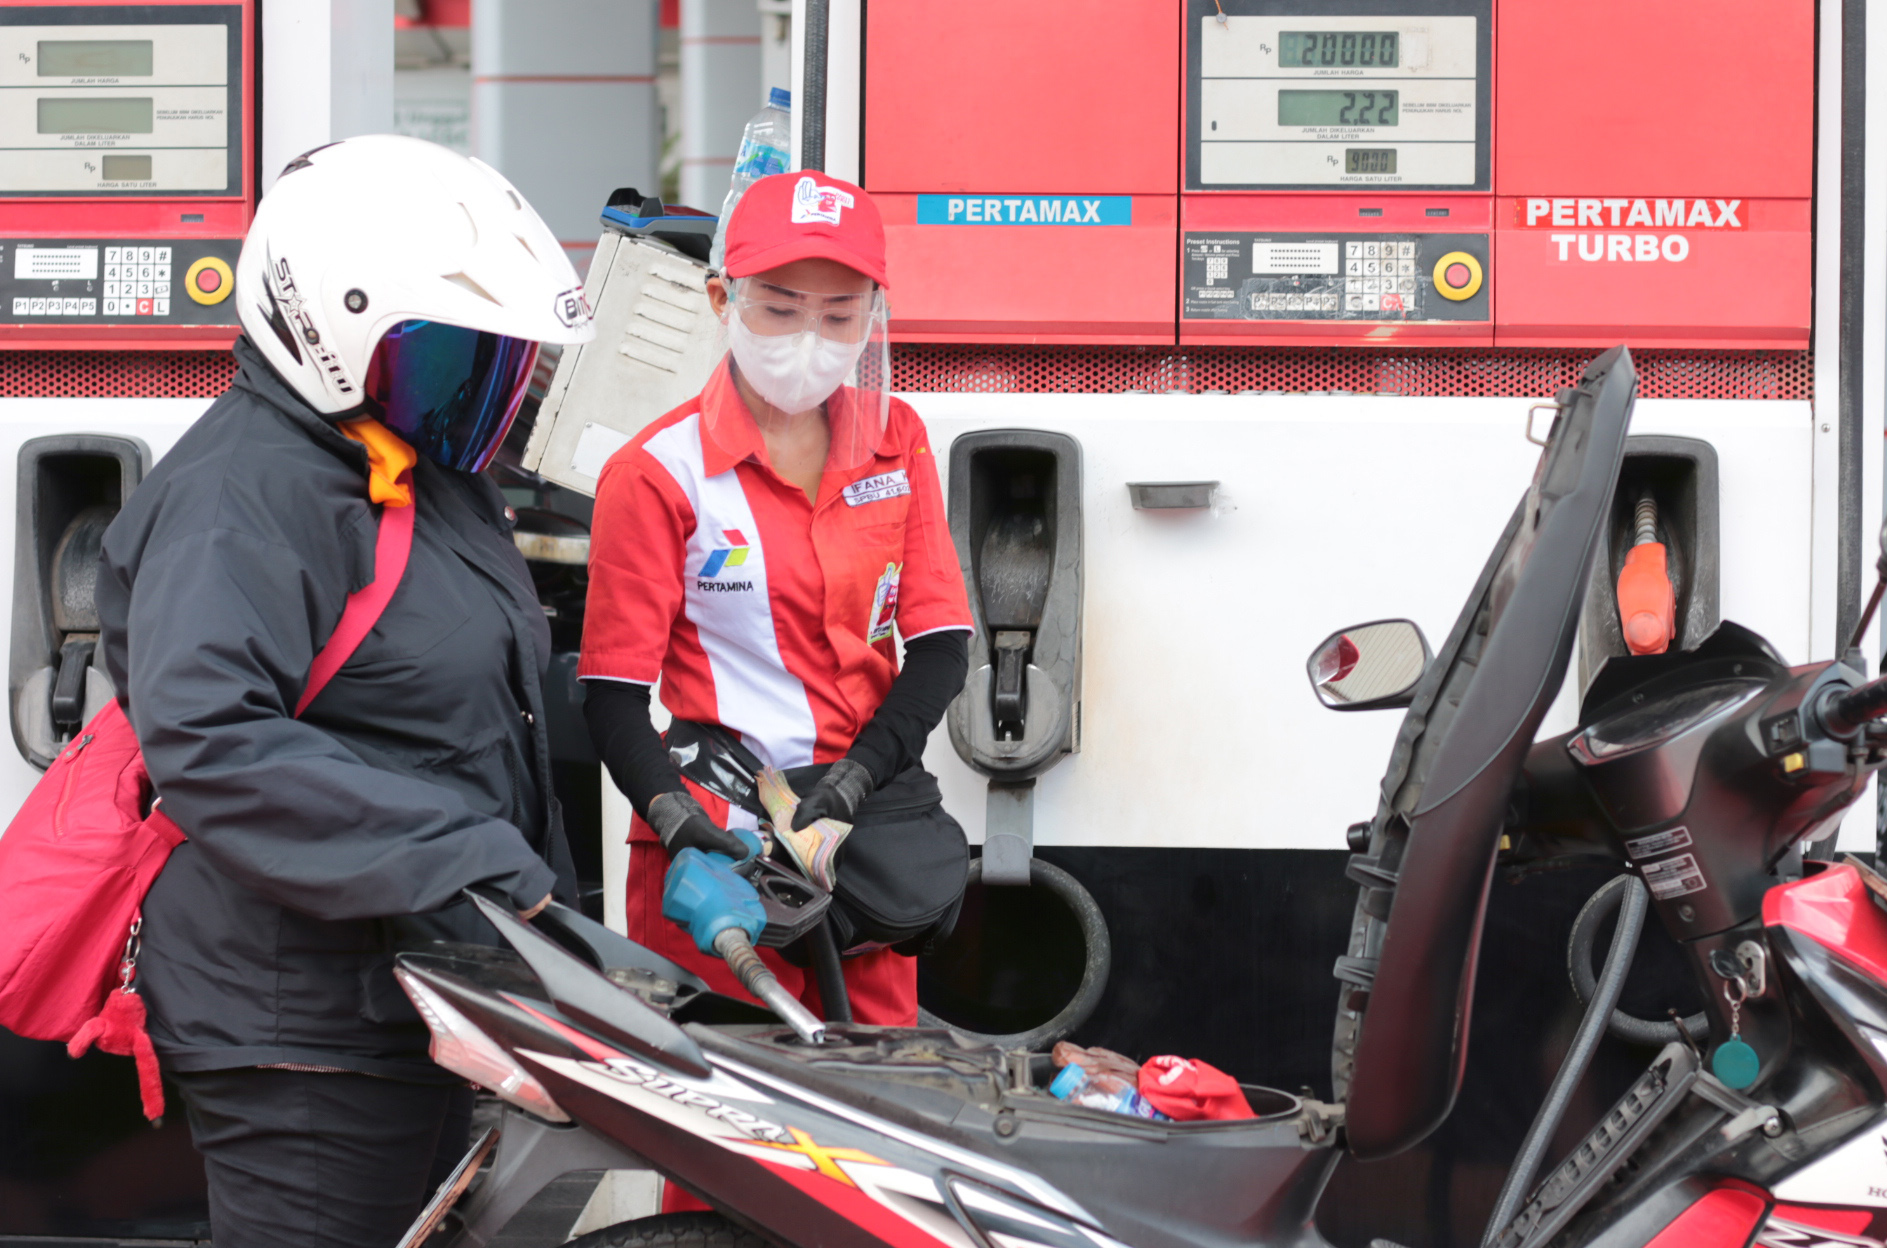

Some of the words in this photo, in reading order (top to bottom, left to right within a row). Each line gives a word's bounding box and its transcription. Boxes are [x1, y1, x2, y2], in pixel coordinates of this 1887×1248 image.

[1260, 44, 1272, 54] Rp
[1302, 34, 1395, 66] 20000
[19, 53, 30, 64] Rp
[1327, 155, 1339, 166] Rp
[84, 162, 96, 173] Rp
[948, 198, 1101, 223] PERTAMAX
[1526, 199, 1742, 227] PERTAMAX
[1350, 245, 1358, 256] 7
[1367, 245, 1376, 256] 8
[1385, 245, 1393, 256] 9
[1402, 245, 1411, 256] #
[1551, 234, 1690, 262] TURBO
[109, 251, 117, 261] 7
[126, 251, 133, 261] 8
[142, 251, 150, 261] 9
[159, 251, 167, 261] #
[108, 268, 116, 278] 4
[126, 268, 133, 278] 5
[142, 268, 150, 278] 6
[1350, 262, 1358, 273] 4
[1367, 262, 1376, 273] 5
[1385, 262, 1393, 273] 6
[109, 284, 115, 294] 1
[124, 284, 132, 294] 2
[141, 284, 149, 294] 3
[1385, 279, 1393, 290] 3
[15, 301, 27, 311] P1
[31, 301, 44, 311] P2
[48, 301, 61, 311] P3
[64, 301, 78, 311] P4
[81, 301, 95, 311] P5
[107, 301, 115, 312] 0
[139, 300, 150, 313] C
[157, 302, 165, 313] L
[850, 475, 896, 494] IFANA
[853, 492, 880, 504] SPBU
[697, 580, 754, 592] PERTAMINA
